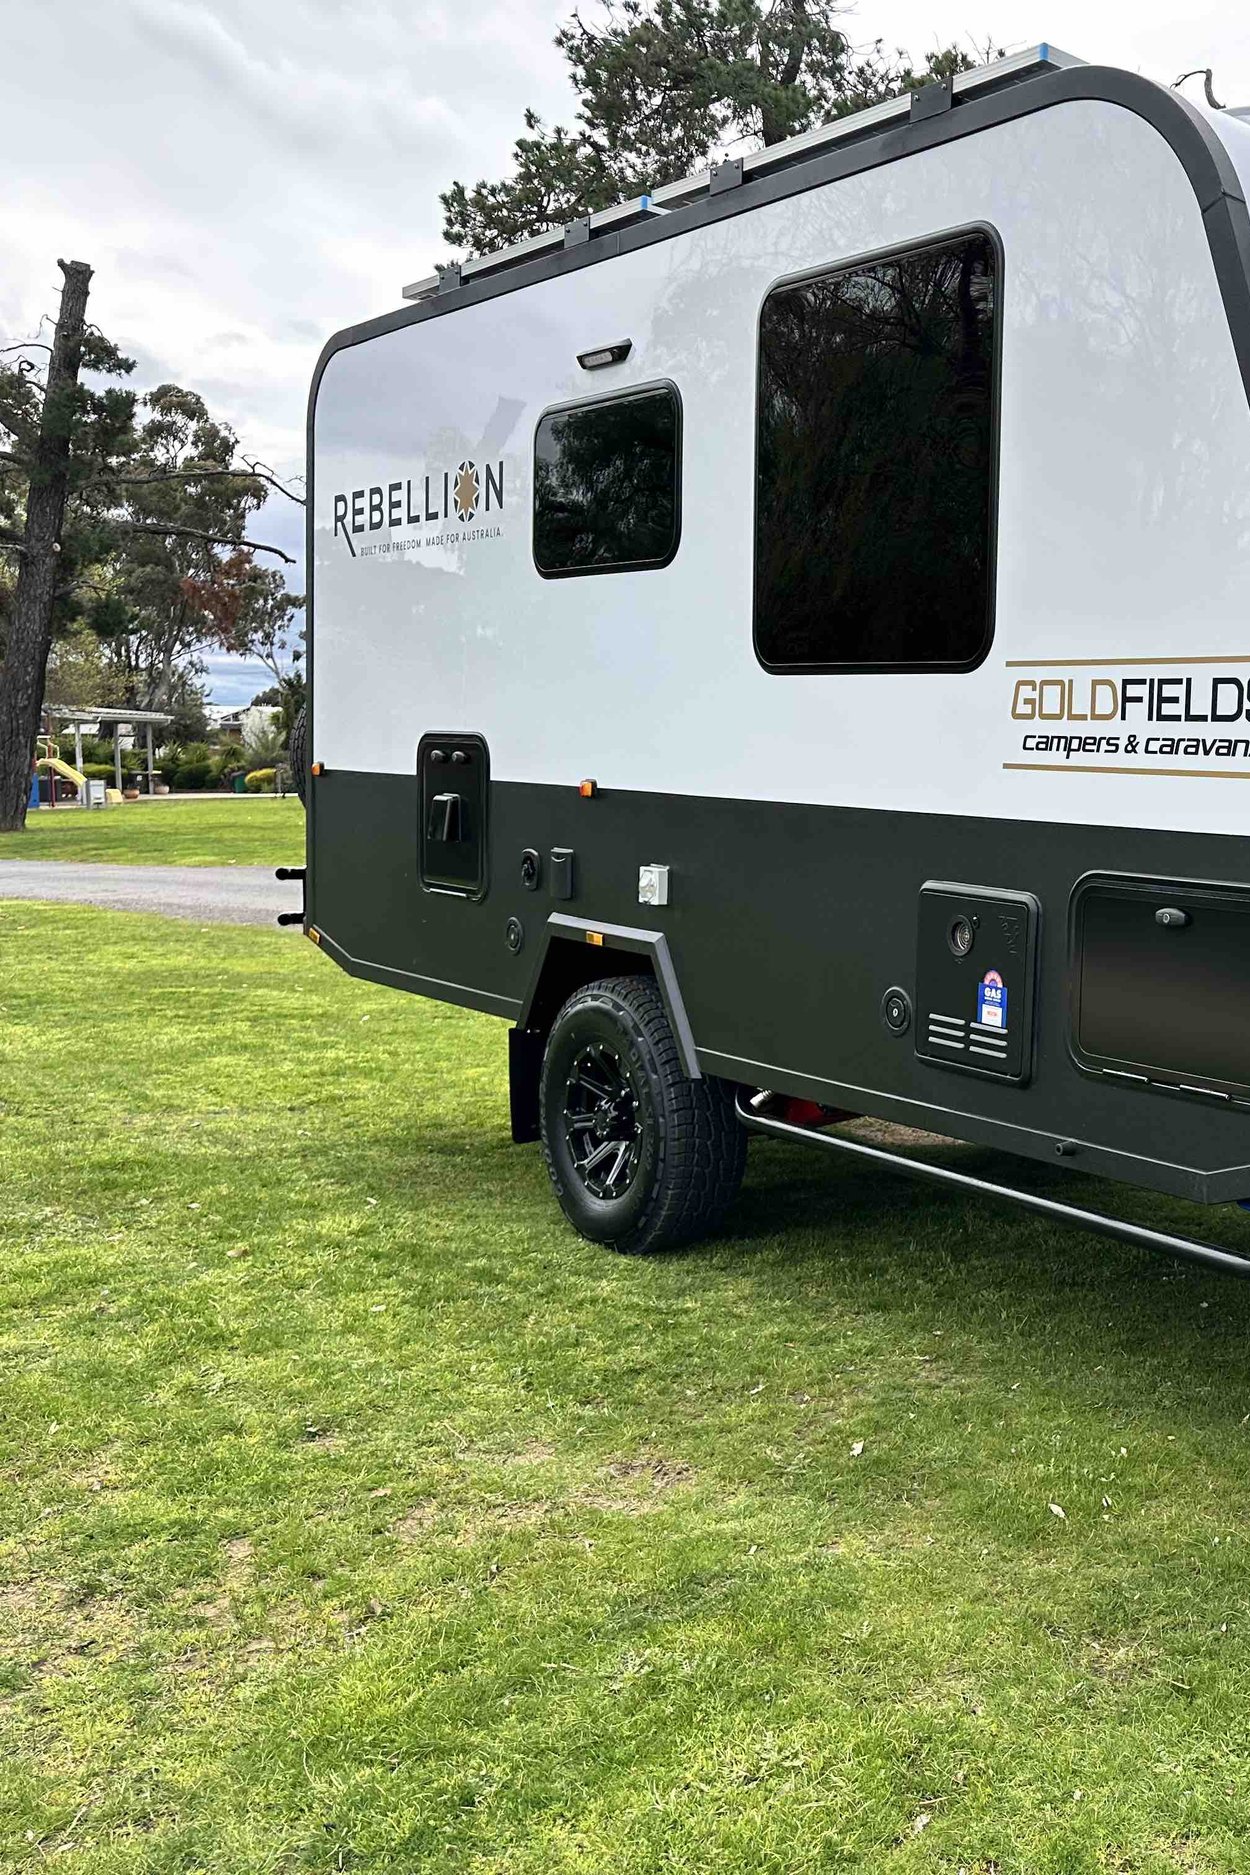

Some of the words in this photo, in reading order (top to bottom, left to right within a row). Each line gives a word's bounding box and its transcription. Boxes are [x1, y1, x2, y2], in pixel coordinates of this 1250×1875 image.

[334, 460, 503, 557] REBELLION
[361, 545, 376, 556] BUILT
[379, 543, 390, 554] FOR
[426, 536, 444, 547] MADE
[446, 533, 460, 545] FOR
[1022, 734, 1120, 759] campers
[1124, 734, 1140, 754] &
[984, 987, 1002, 999] GAS
